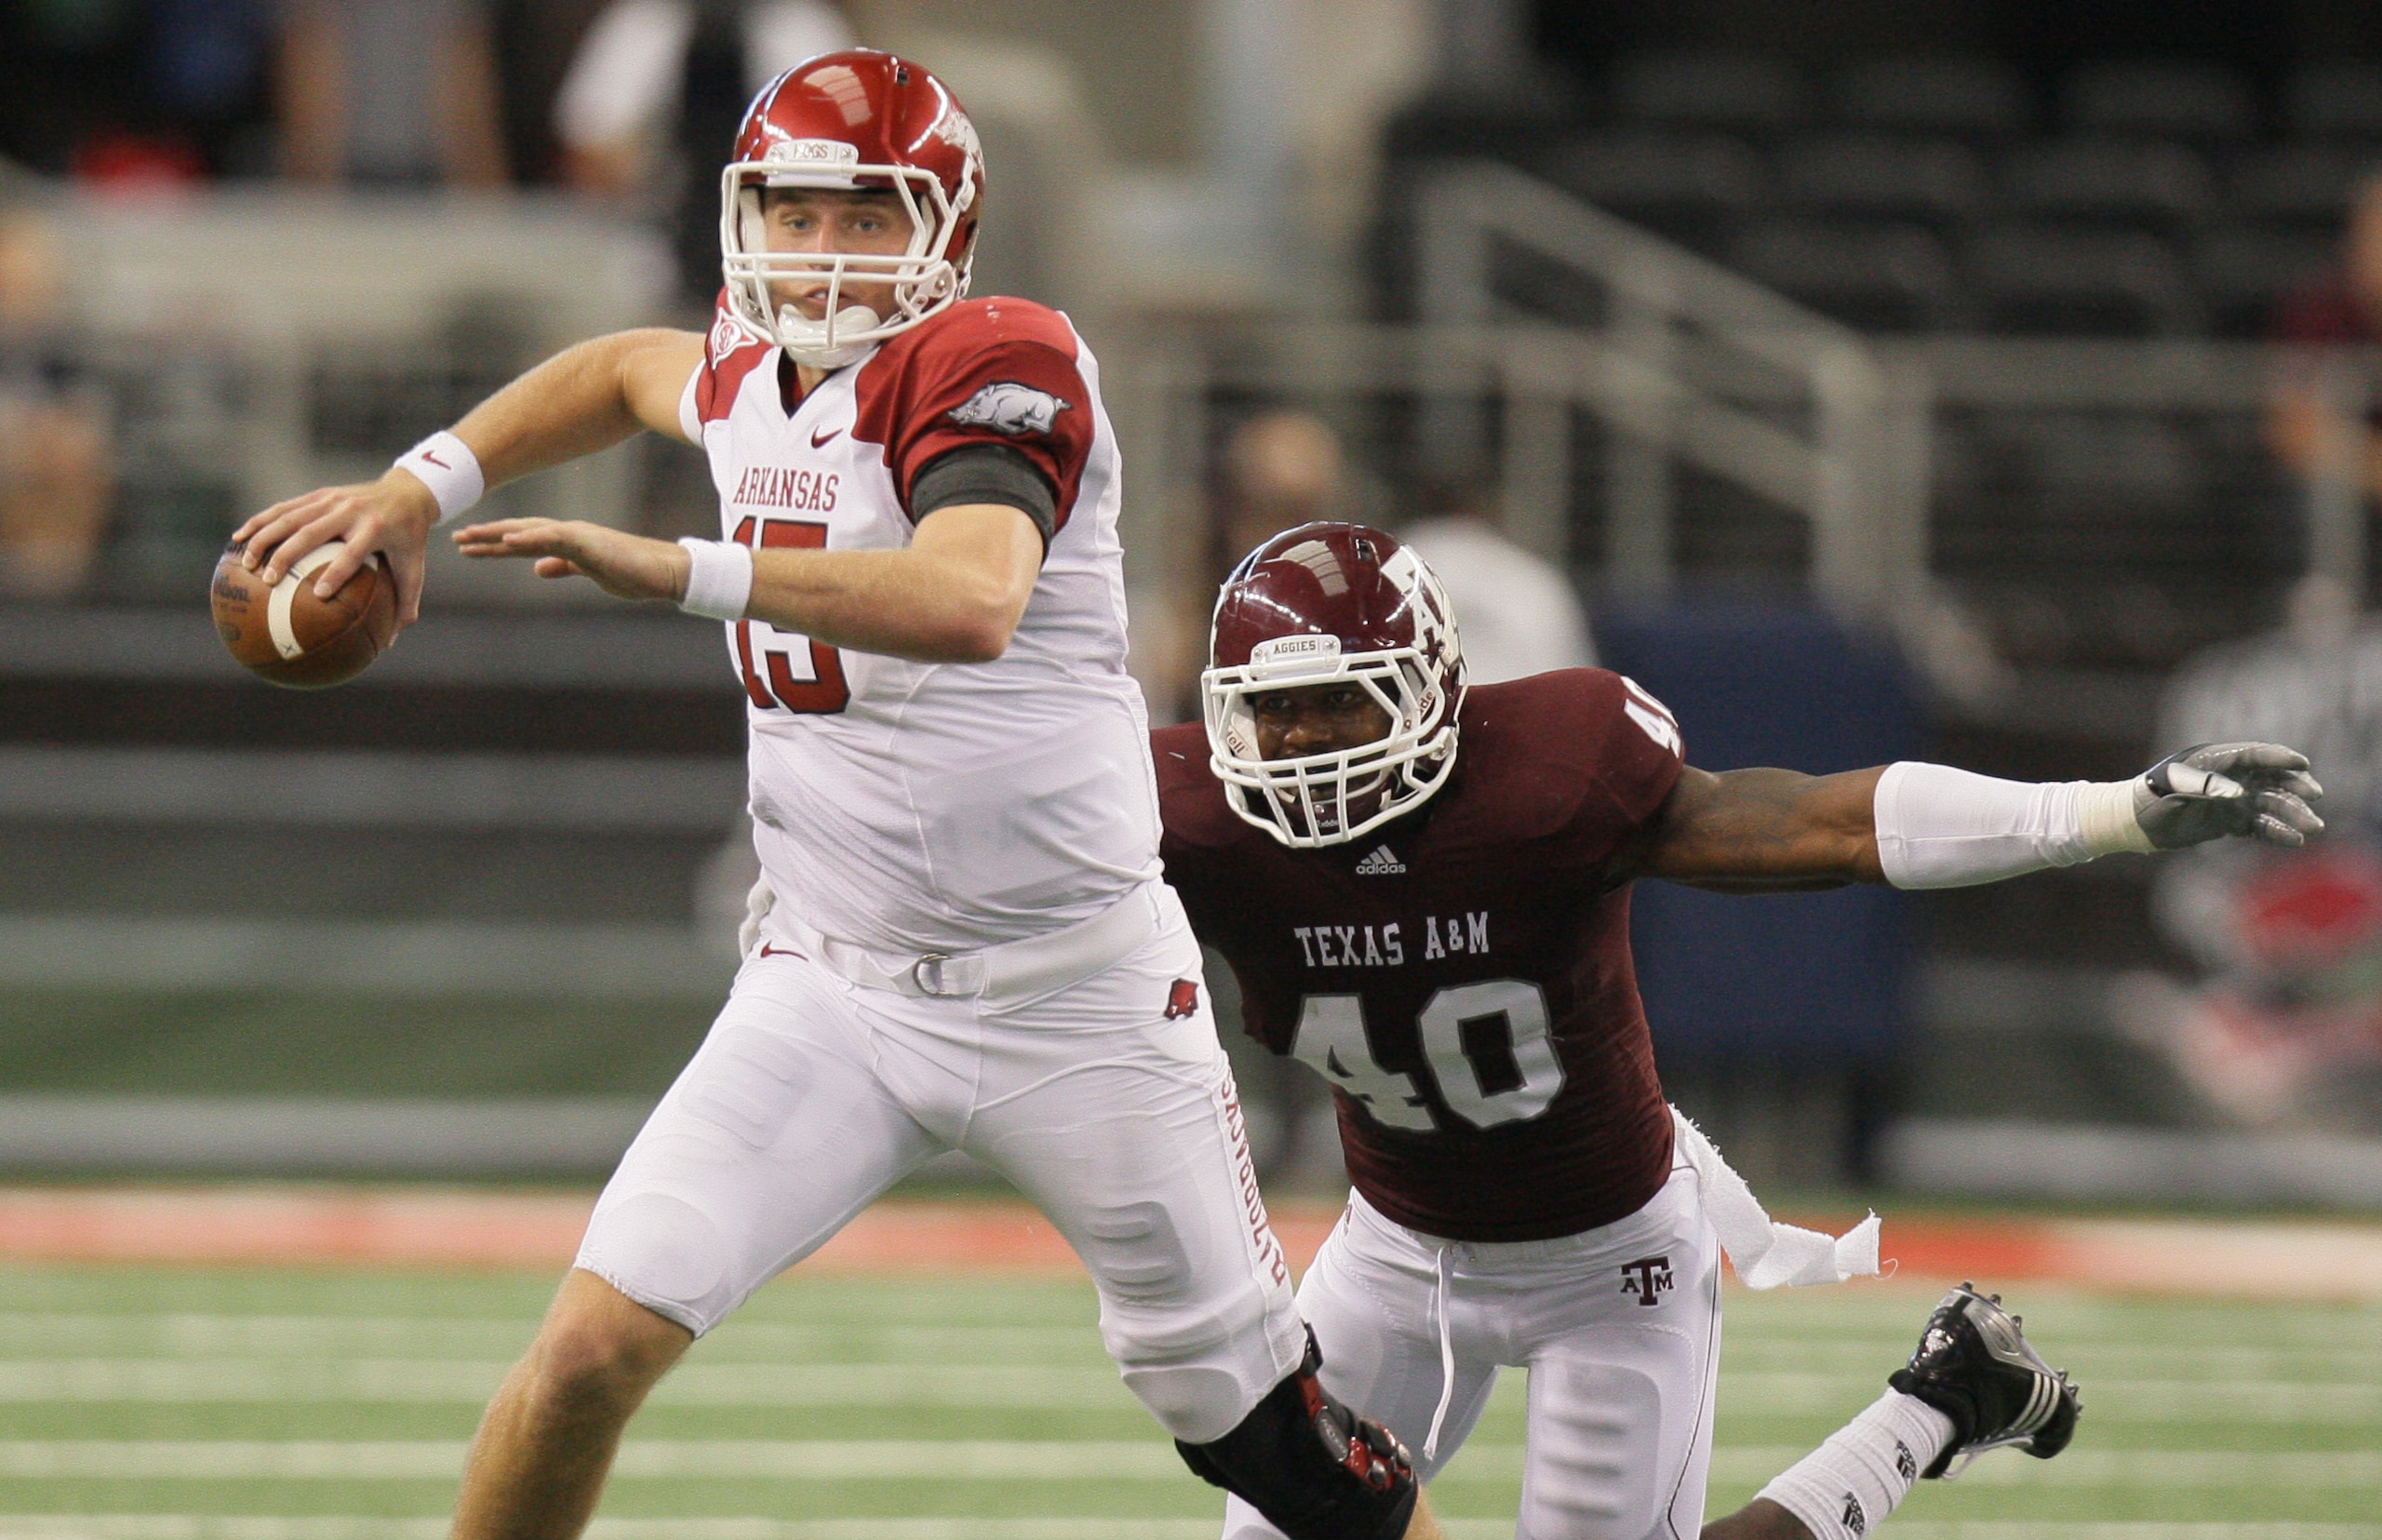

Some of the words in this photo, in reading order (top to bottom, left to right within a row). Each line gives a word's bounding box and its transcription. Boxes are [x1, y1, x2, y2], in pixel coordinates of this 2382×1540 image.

[732, 466, 839, 513] ARKANSAS
[1273, 640, 1318, 655] AGGIES
[1356, 861, 1406, 875] adidas
[1294, 922, 1404, 968] TEXAS
[1425, 910, 1490, 960] A&M
[1289, 977, 1567, 1132] 40
